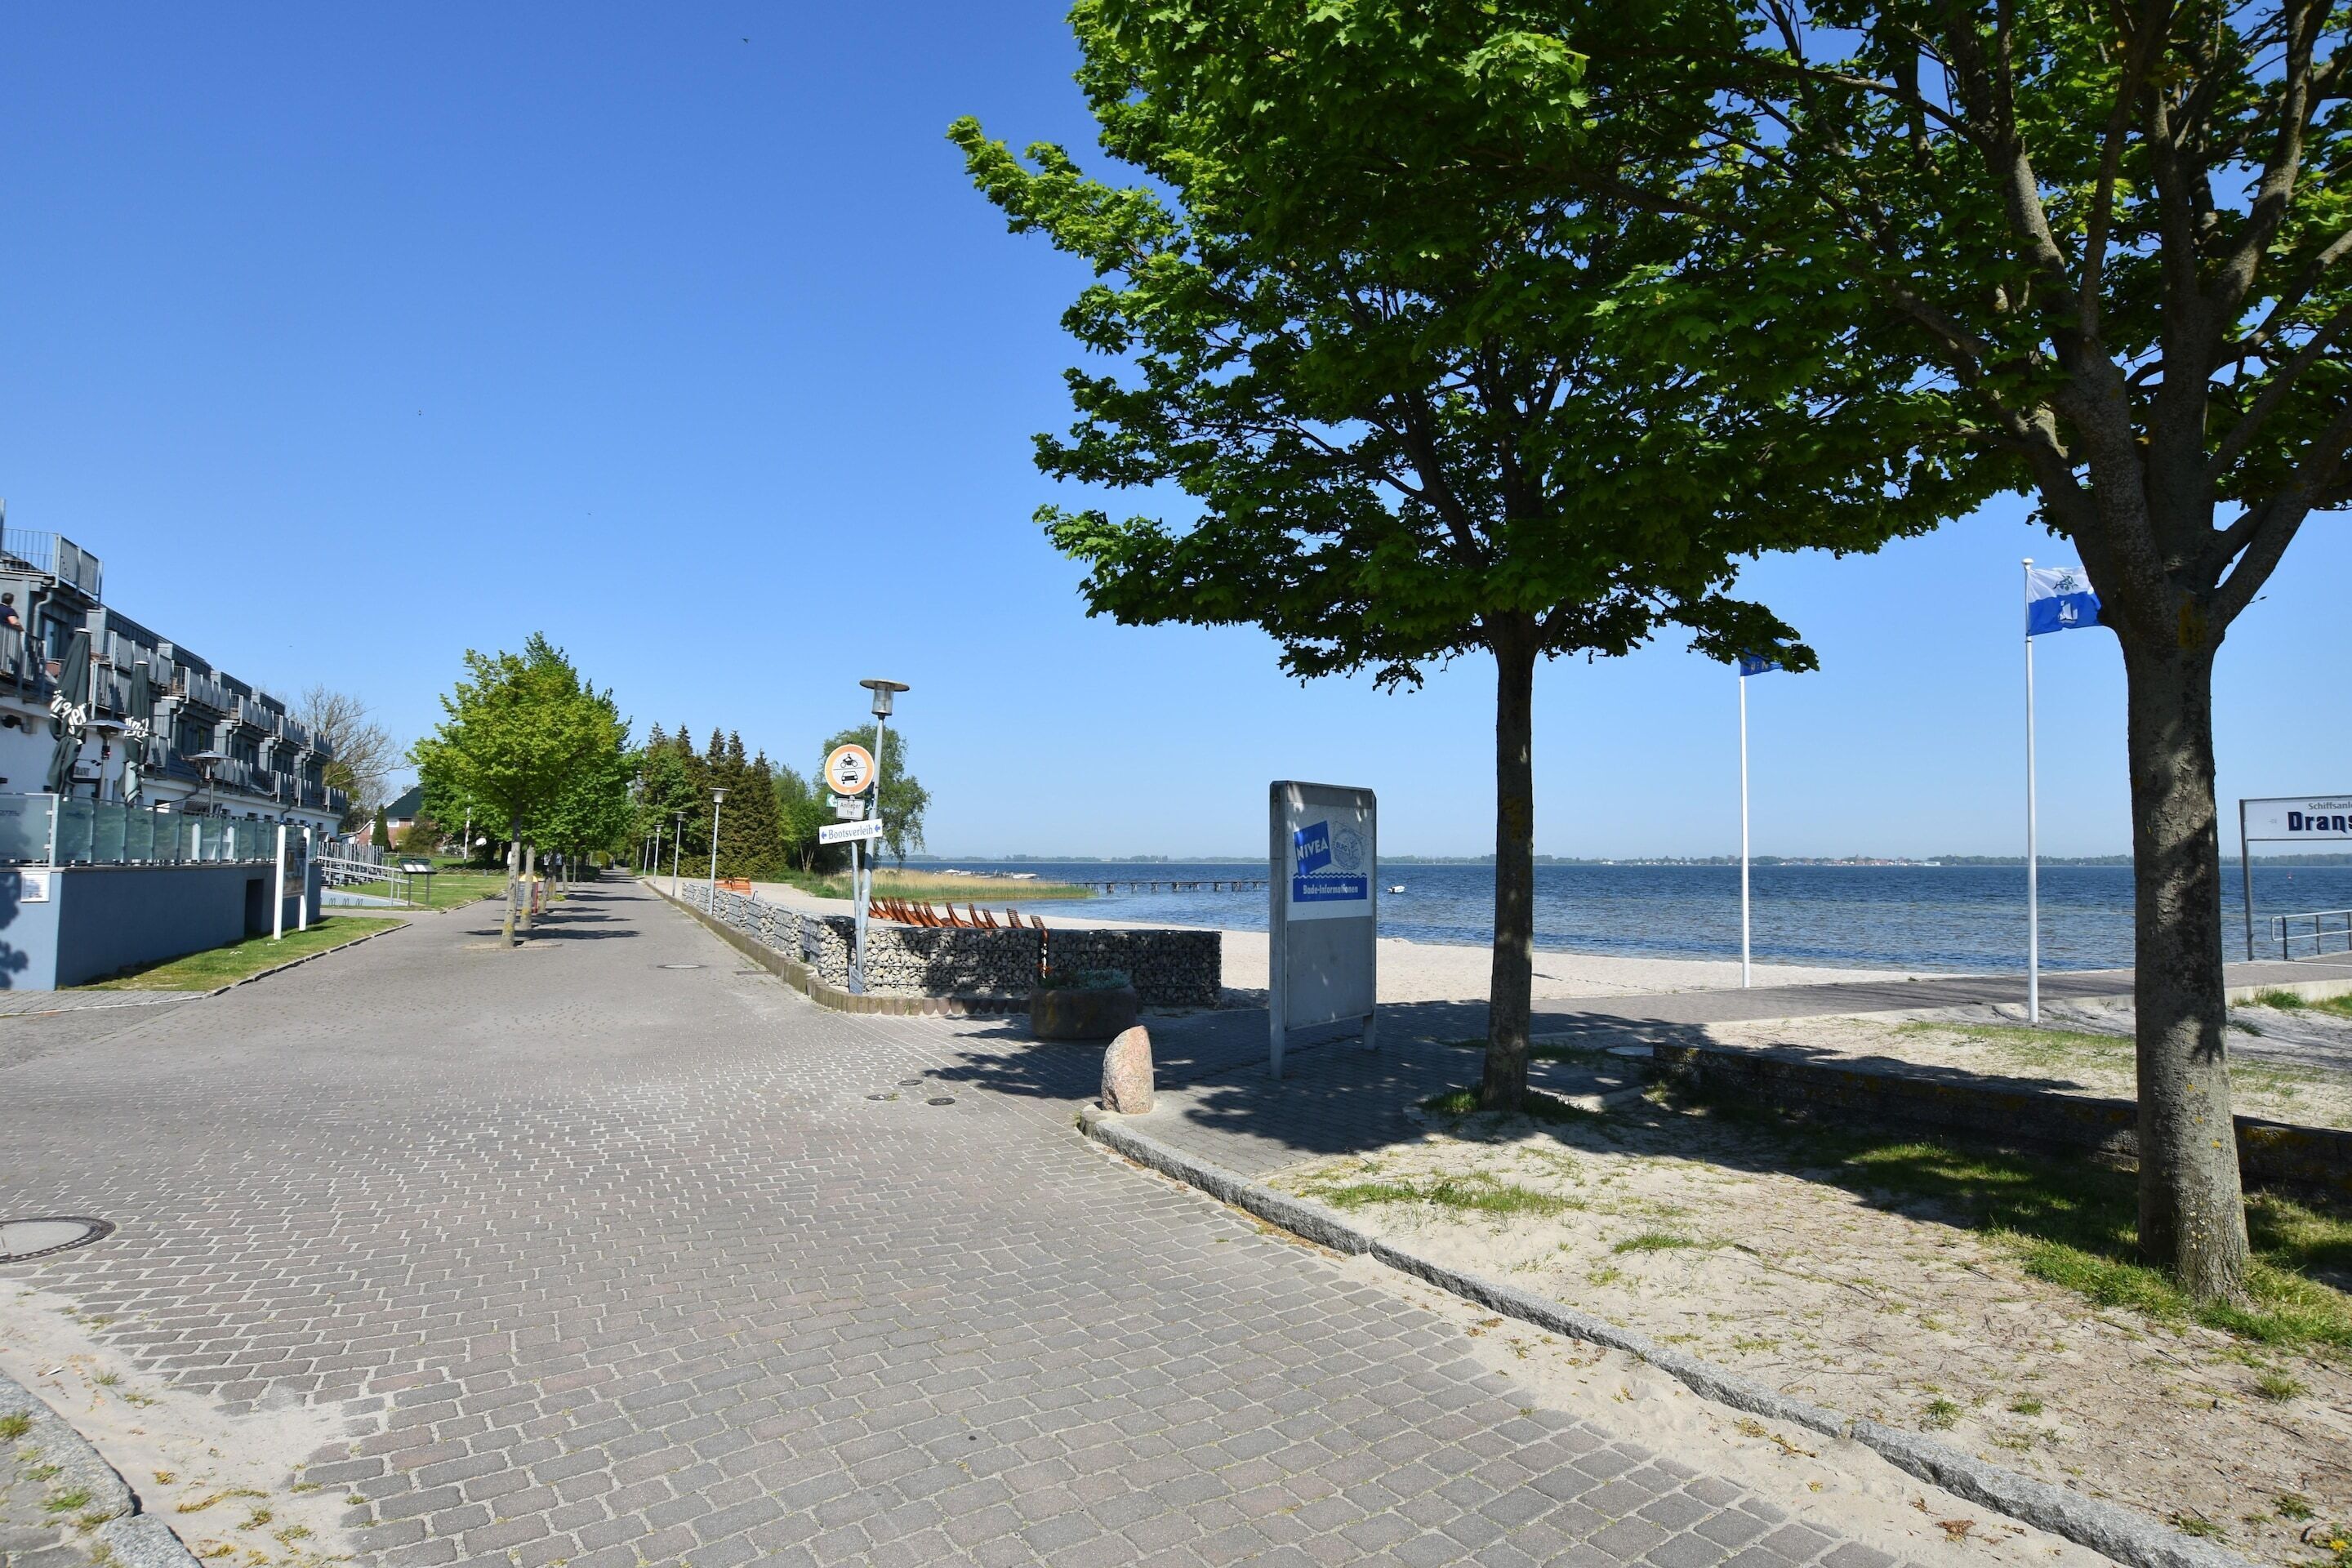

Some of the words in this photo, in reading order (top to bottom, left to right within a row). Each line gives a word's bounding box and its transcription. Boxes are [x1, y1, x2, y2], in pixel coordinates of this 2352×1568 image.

[828, 824, 873, 840] Bootsverleih
[1296, 837, 1329, 862] NIVEA
[1303, 884, 1358, 894] Bade-Informationen
